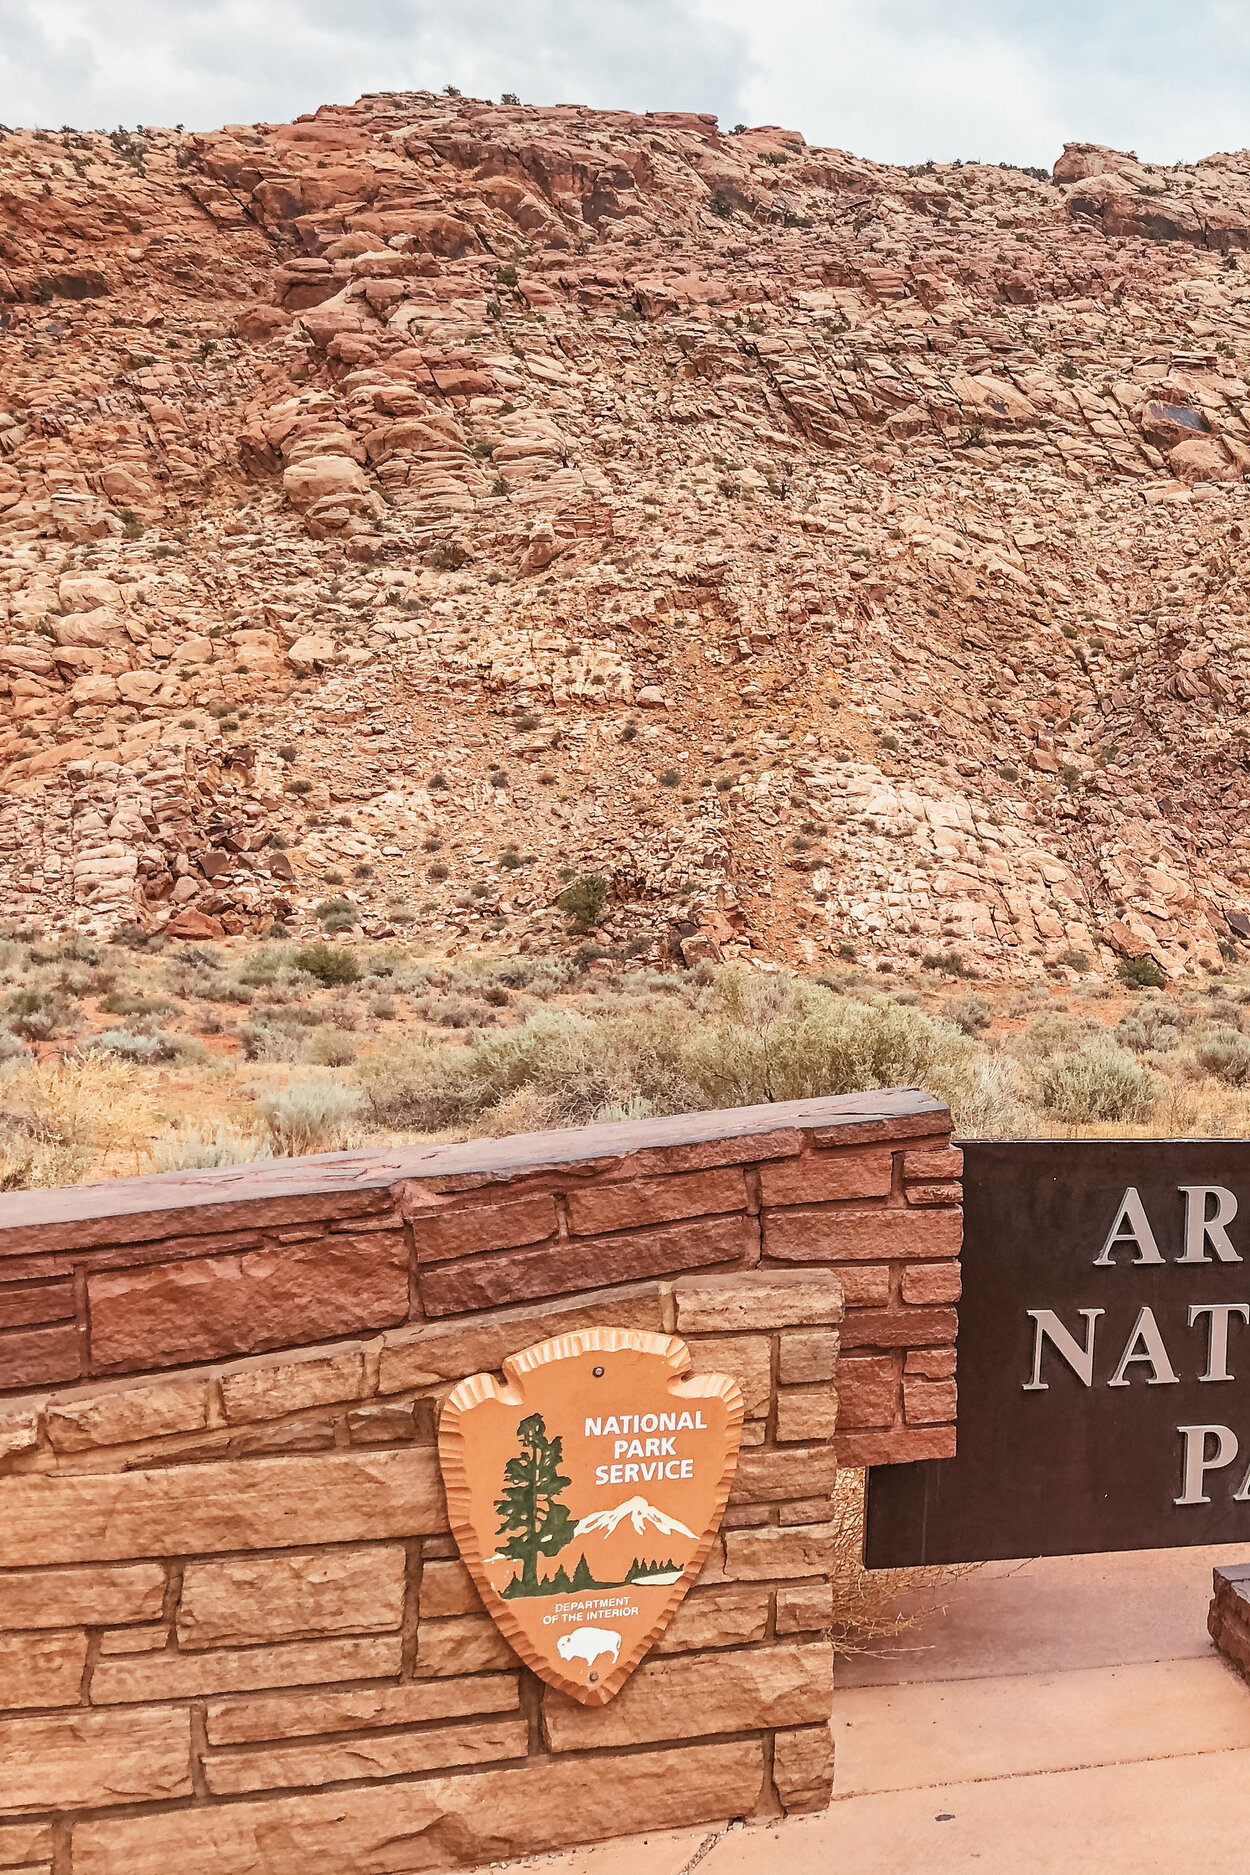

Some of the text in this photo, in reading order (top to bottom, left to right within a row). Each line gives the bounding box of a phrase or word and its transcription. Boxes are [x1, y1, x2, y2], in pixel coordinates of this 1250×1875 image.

[585, 1411, 707, 1436] NATIONAL
[614, 1437, 677, 1459] PARK
[595, 1459, 694, 1485] SERVICE
[543, 1607, 639, 1624] OF THE INTERIOR
[555, 1597, 630, 1612] DEPARTMENT
